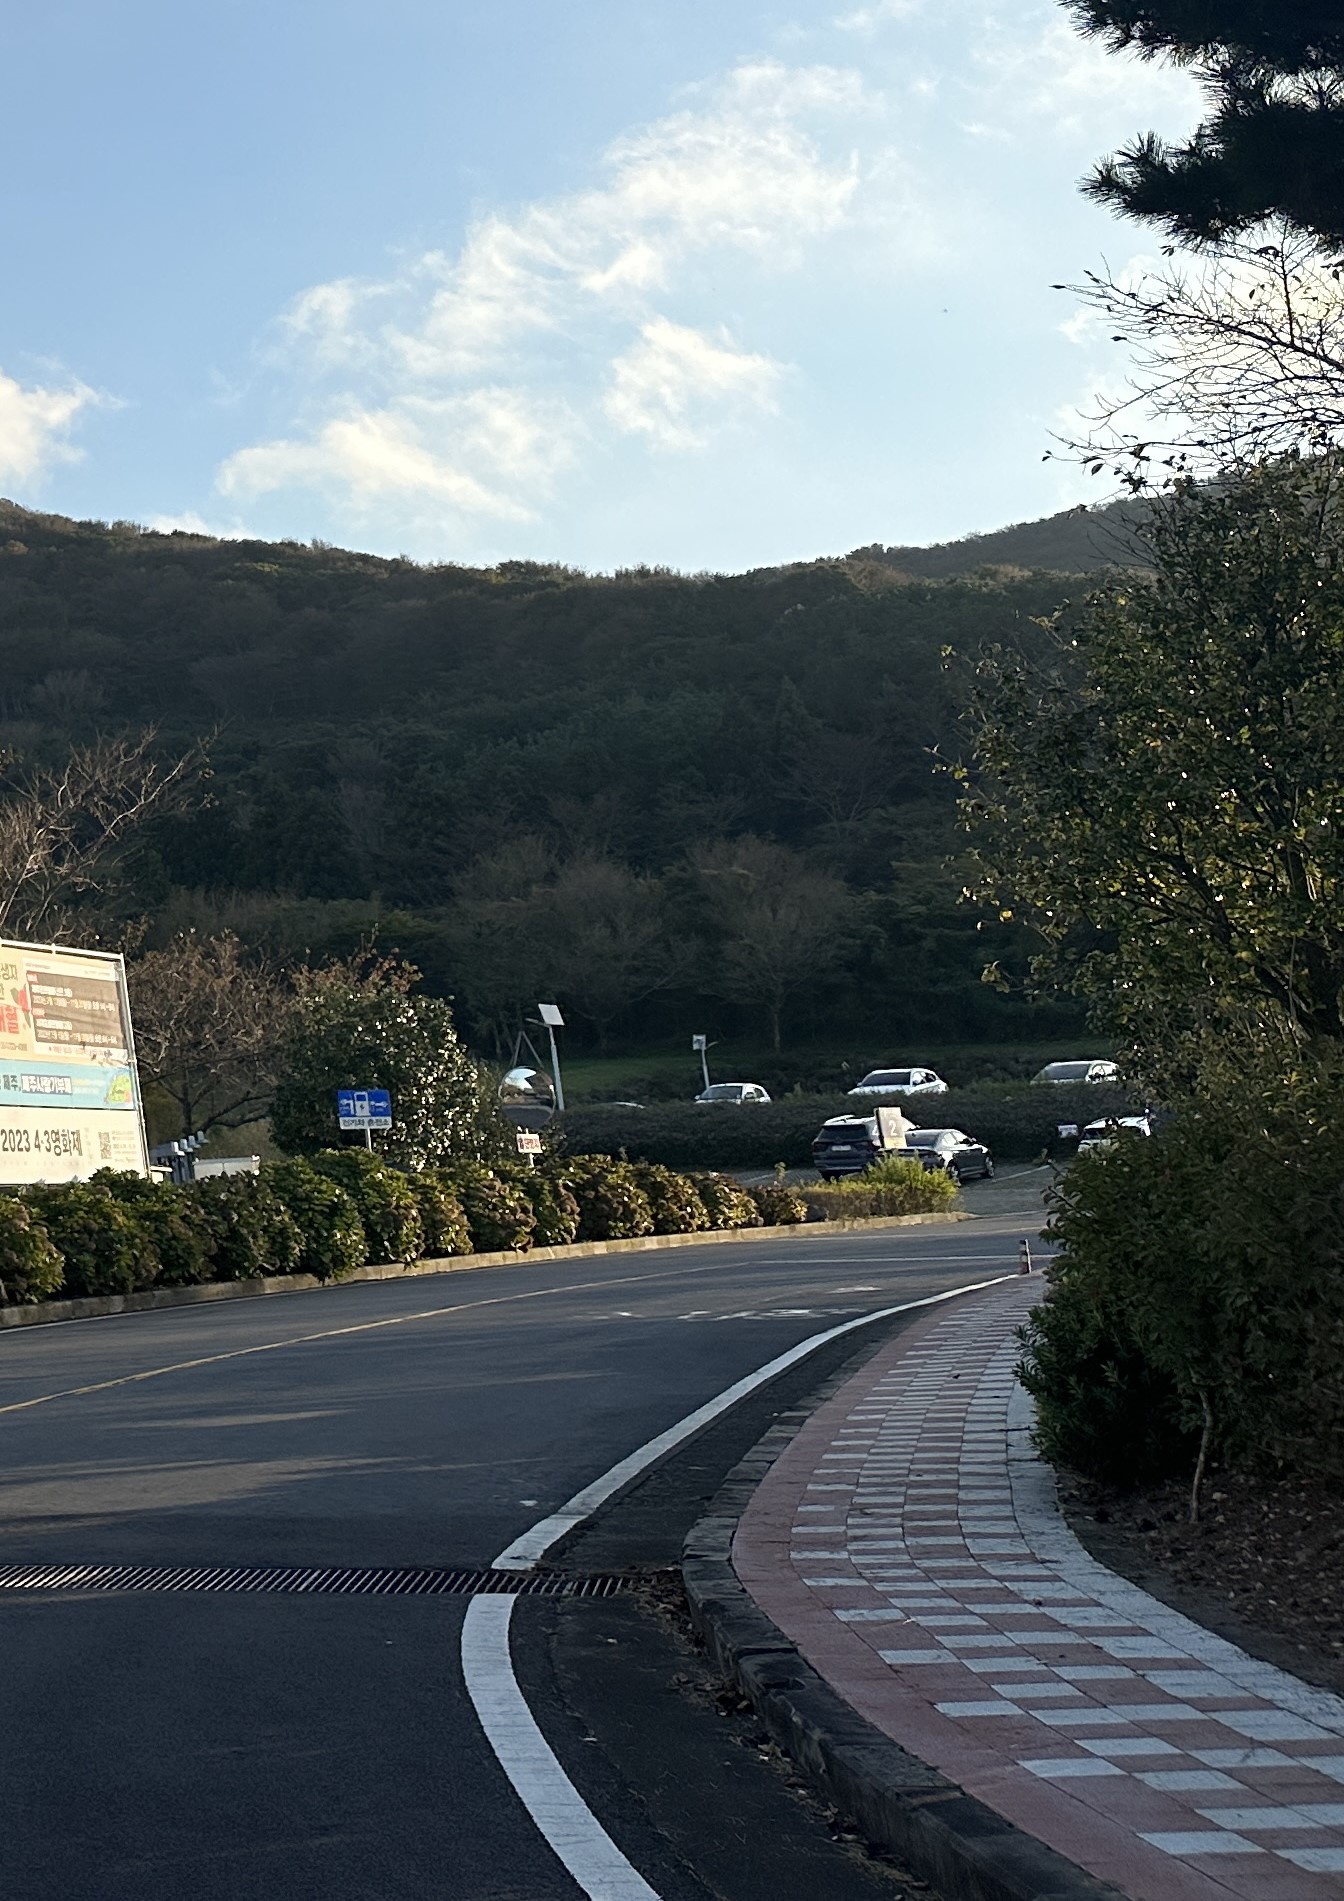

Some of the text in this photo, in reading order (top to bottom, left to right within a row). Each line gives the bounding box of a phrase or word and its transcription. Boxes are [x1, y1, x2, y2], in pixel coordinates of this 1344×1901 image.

[888, 1120, 897, 1136] 2
[1, 1128, 30, 1152] 2023
[34, 1128, 83, 1156] 4·3영화제
